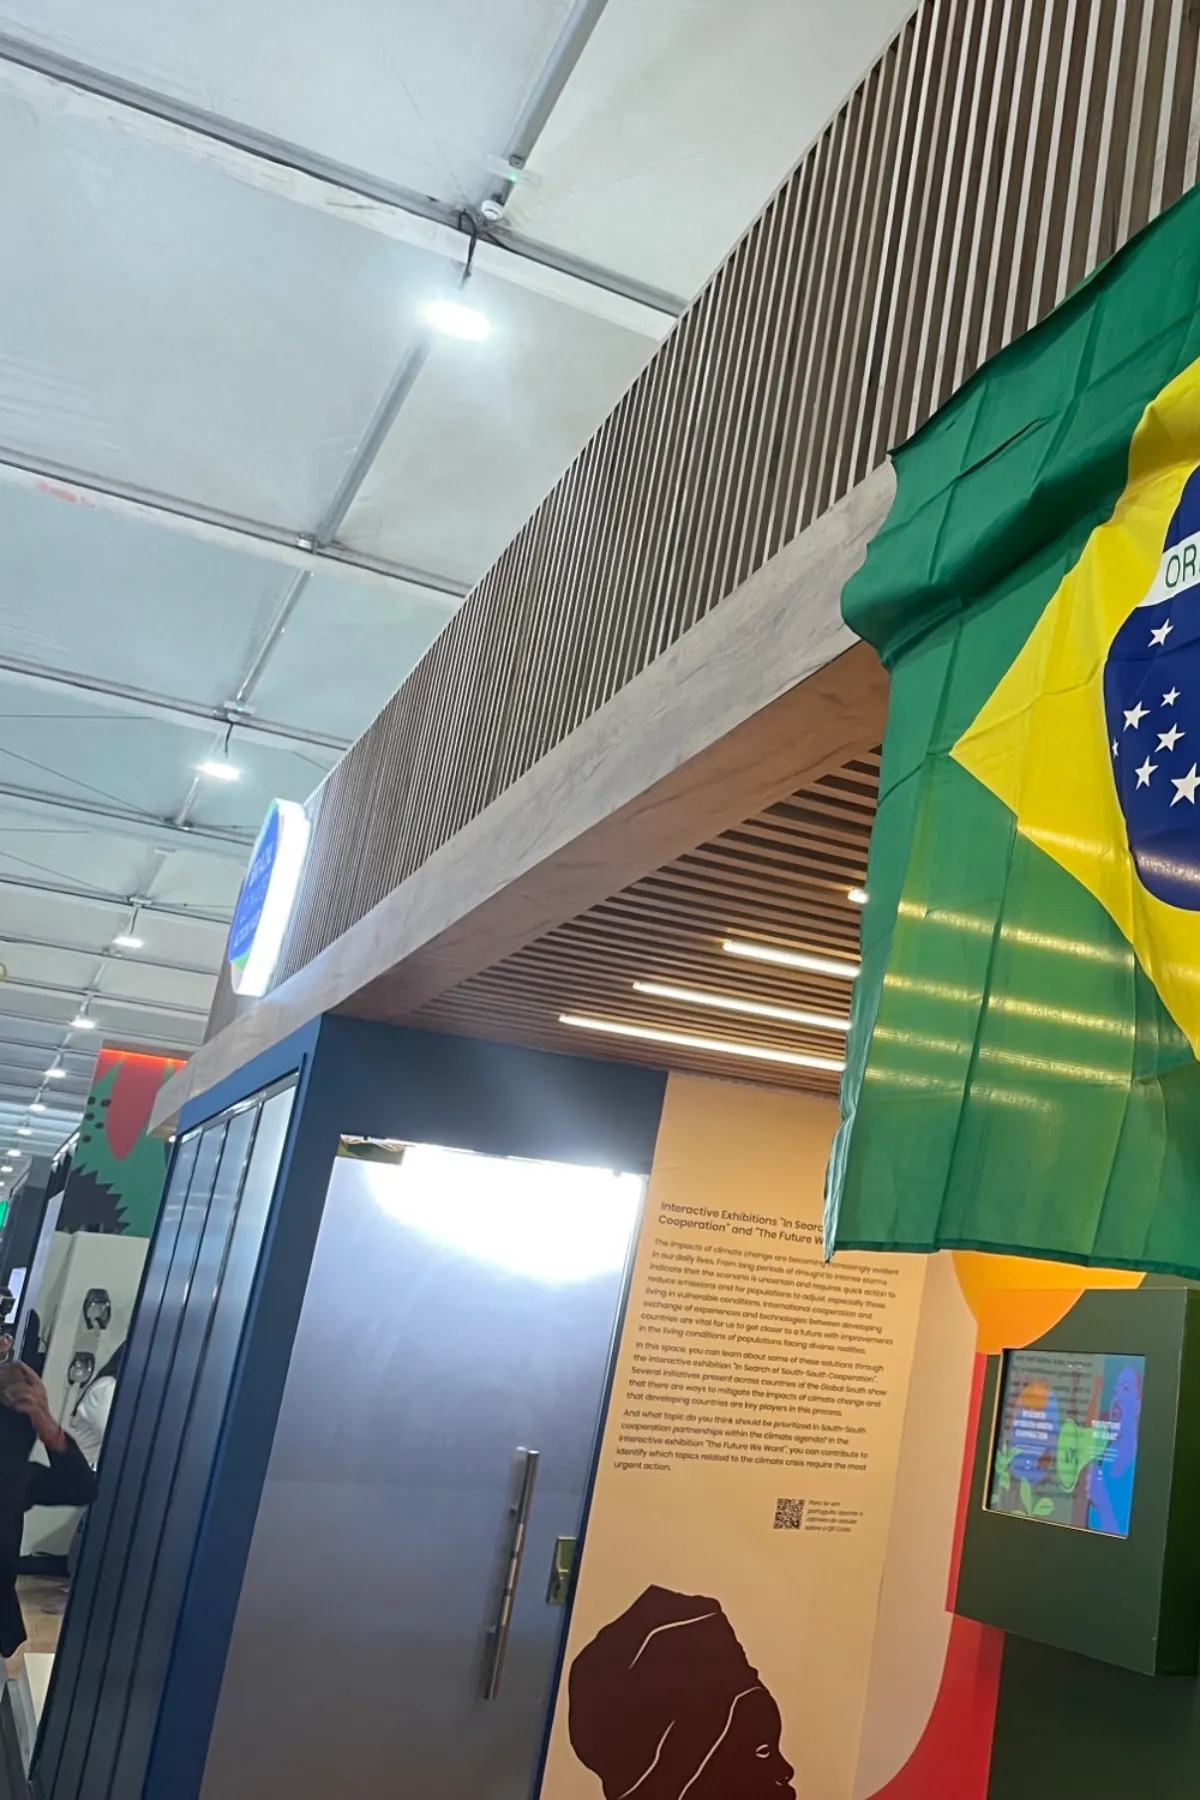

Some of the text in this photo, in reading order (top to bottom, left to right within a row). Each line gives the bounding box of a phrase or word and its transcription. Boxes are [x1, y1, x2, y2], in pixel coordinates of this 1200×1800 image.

[658, 1216, 728, 1233] Cooperation"
[730, 1226, 752, 1236] and
[779, 1231, 812, 1243] Future
[814, 1236, 824, 1245] W
[661, 1202, 719, 1218] Interactive
[721, 1210, 777, 1226] Exhibitions
[794, 1220, 823, 1232] Searc
